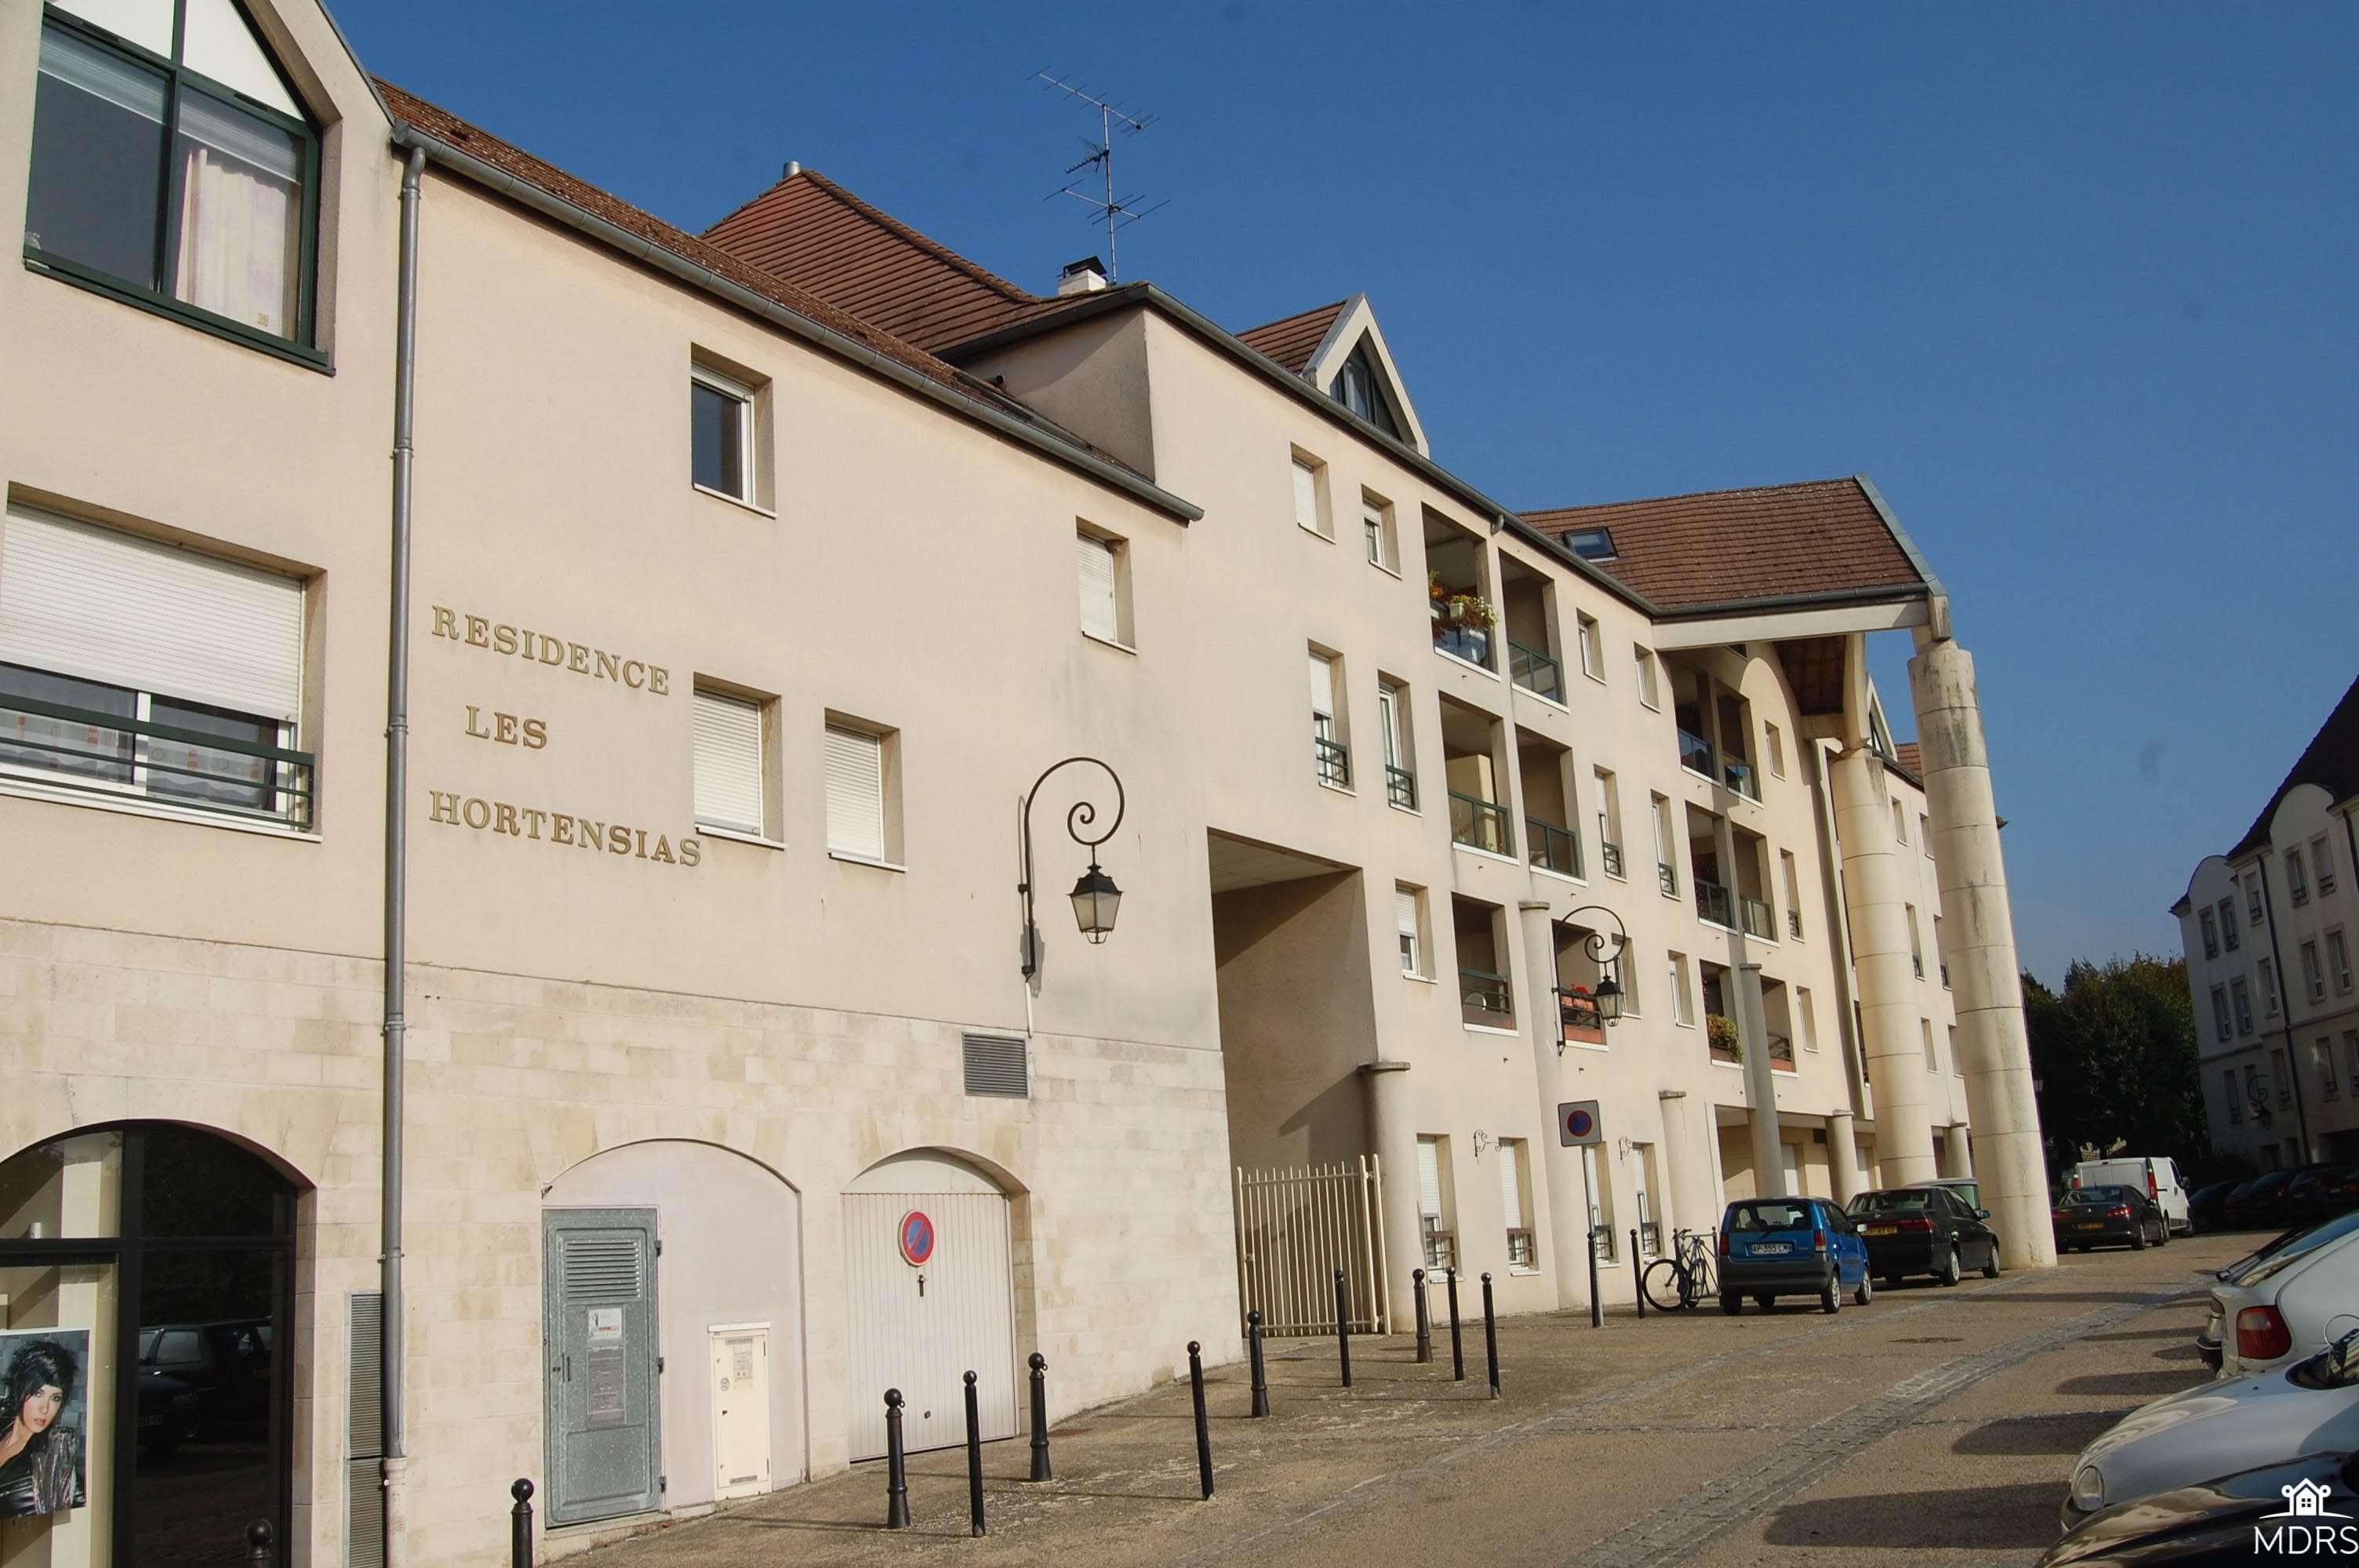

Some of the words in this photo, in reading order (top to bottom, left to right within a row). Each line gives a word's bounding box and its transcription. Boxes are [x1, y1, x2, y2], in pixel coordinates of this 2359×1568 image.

[432, 605, 669, 695] RESIDENCE
[465, 705, 547, 749] LES
[429, 790, 700, 866] HORTENSIAS
